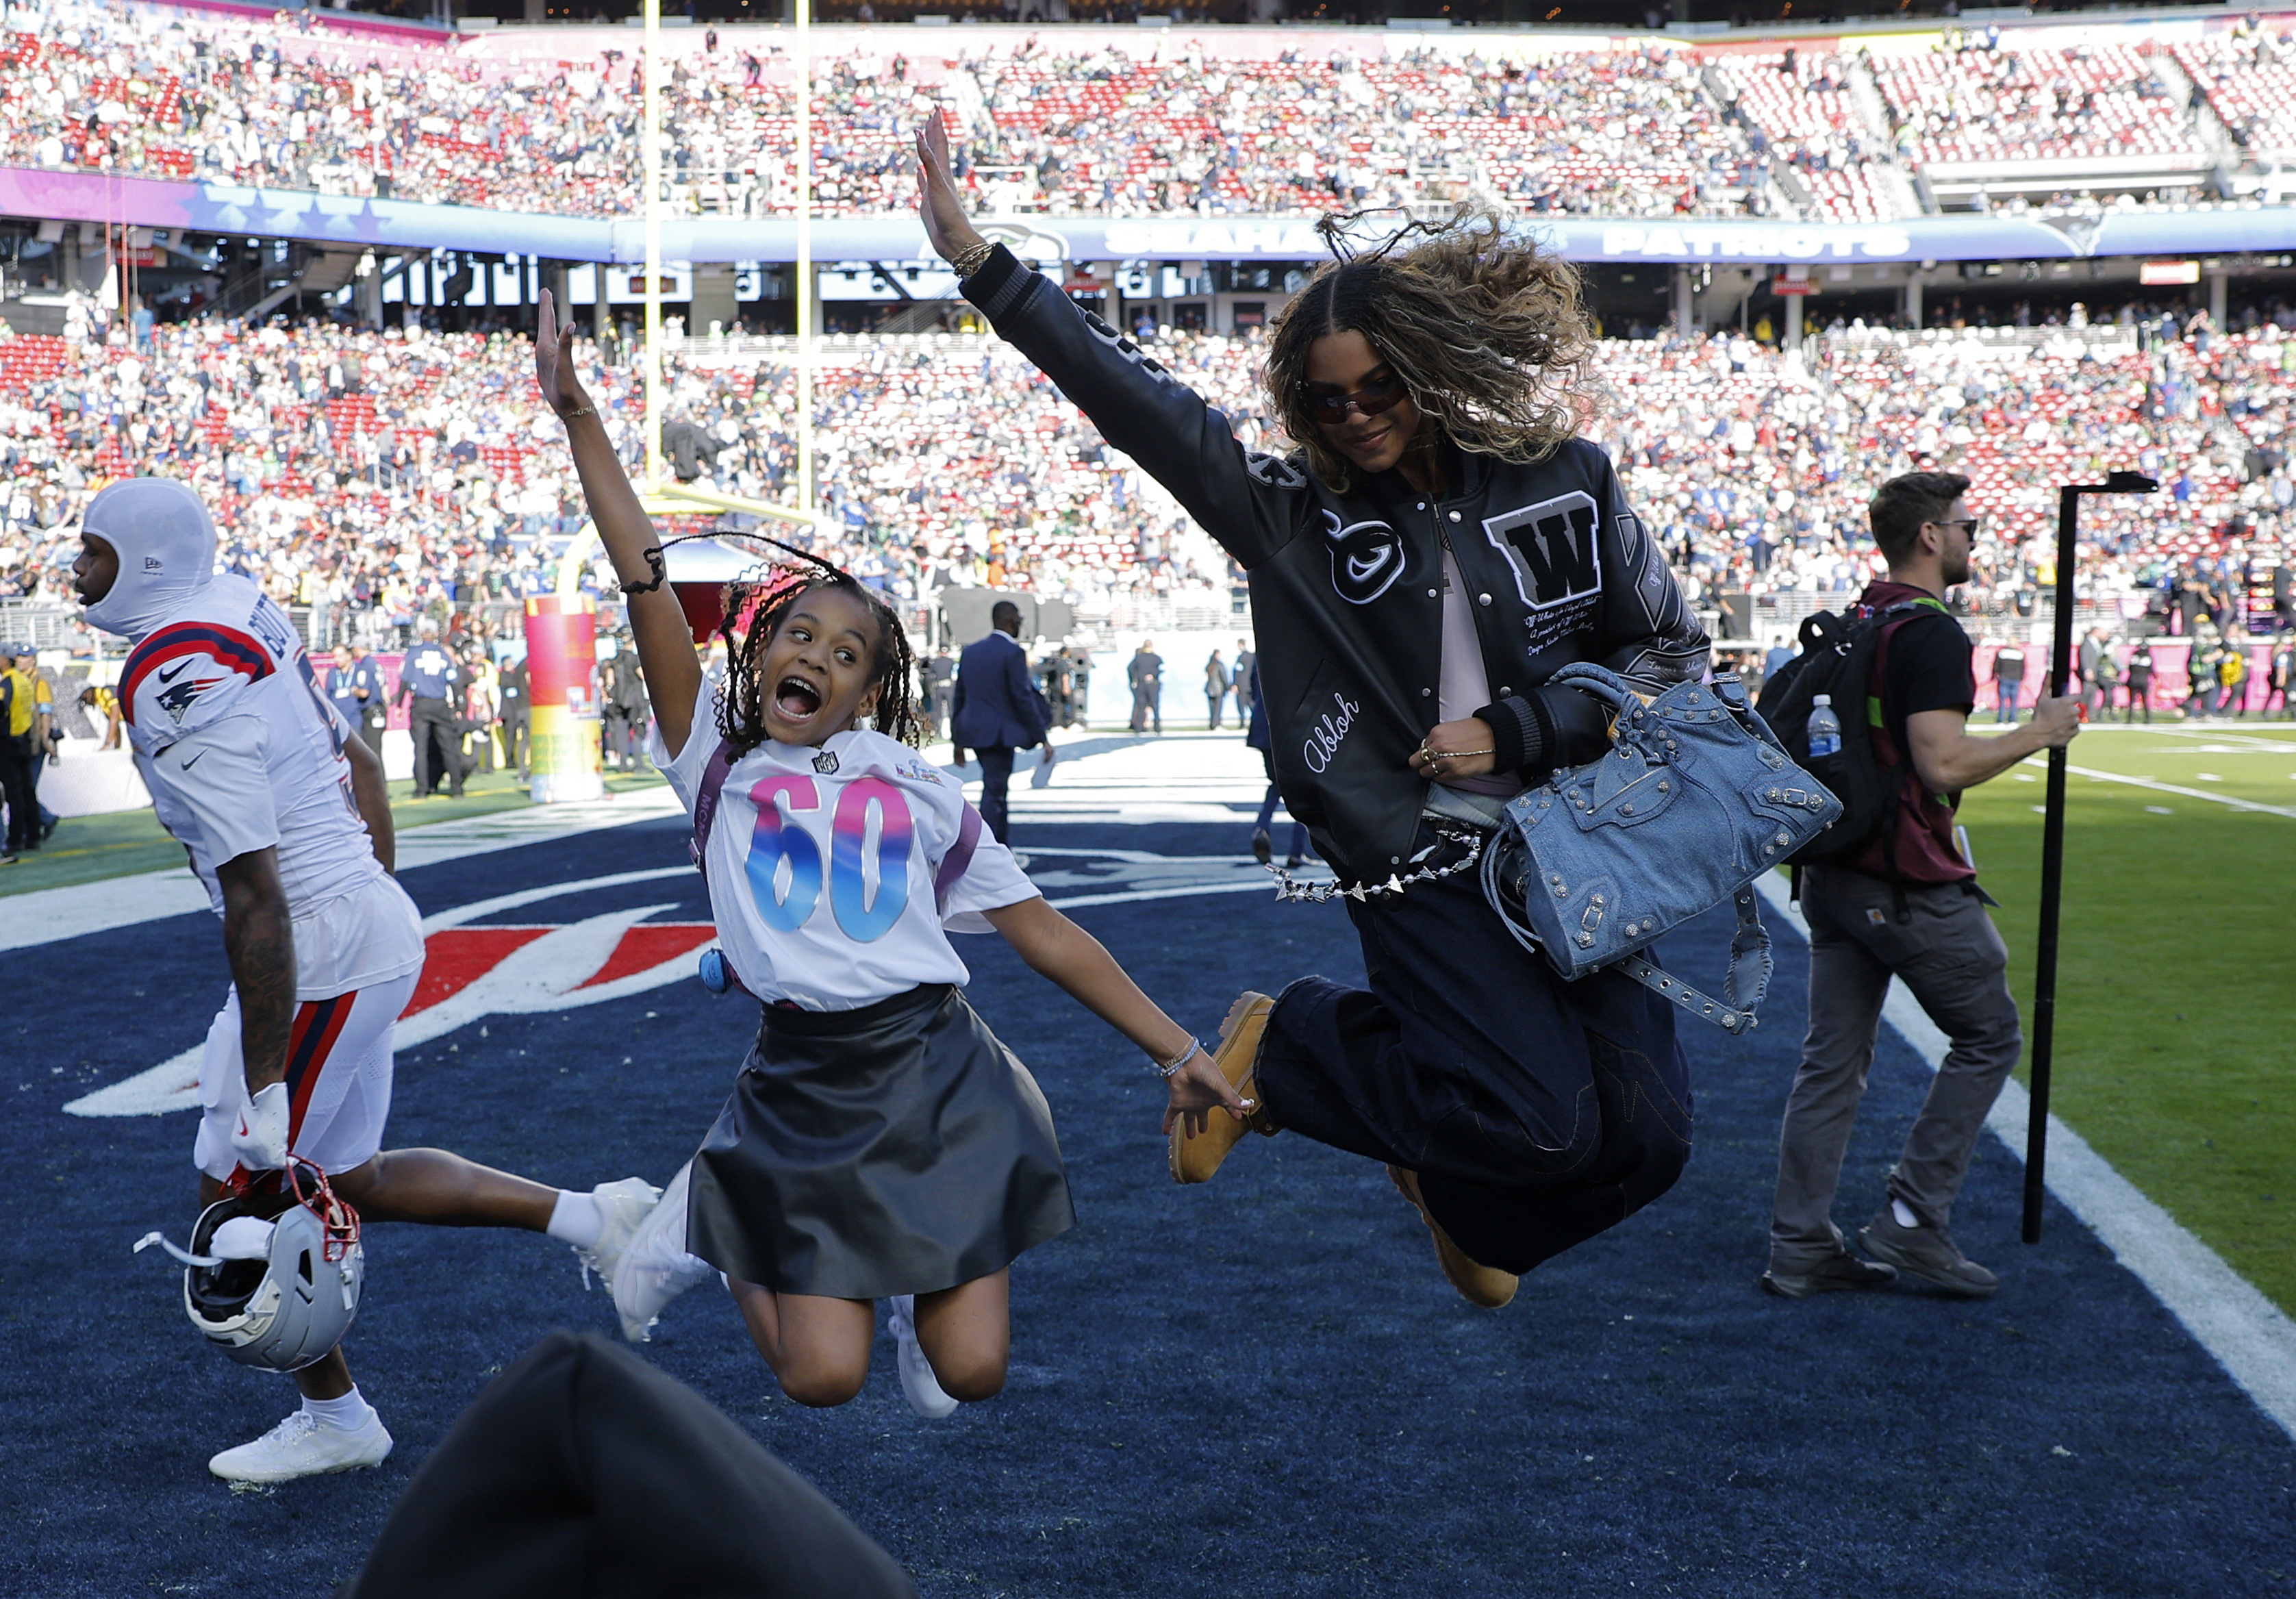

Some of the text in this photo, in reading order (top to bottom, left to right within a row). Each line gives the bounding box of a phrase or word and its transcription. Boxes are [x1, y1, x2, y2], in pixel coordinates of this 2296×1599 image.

[1603, 227, 1910, 258] PATRIOTS
[1481, 490, 1602, 611] W
[1304, 692, 1360, 774] Abloh
[698, 792, 712, 837] MCM
[744, 772, 916, 944] 60
